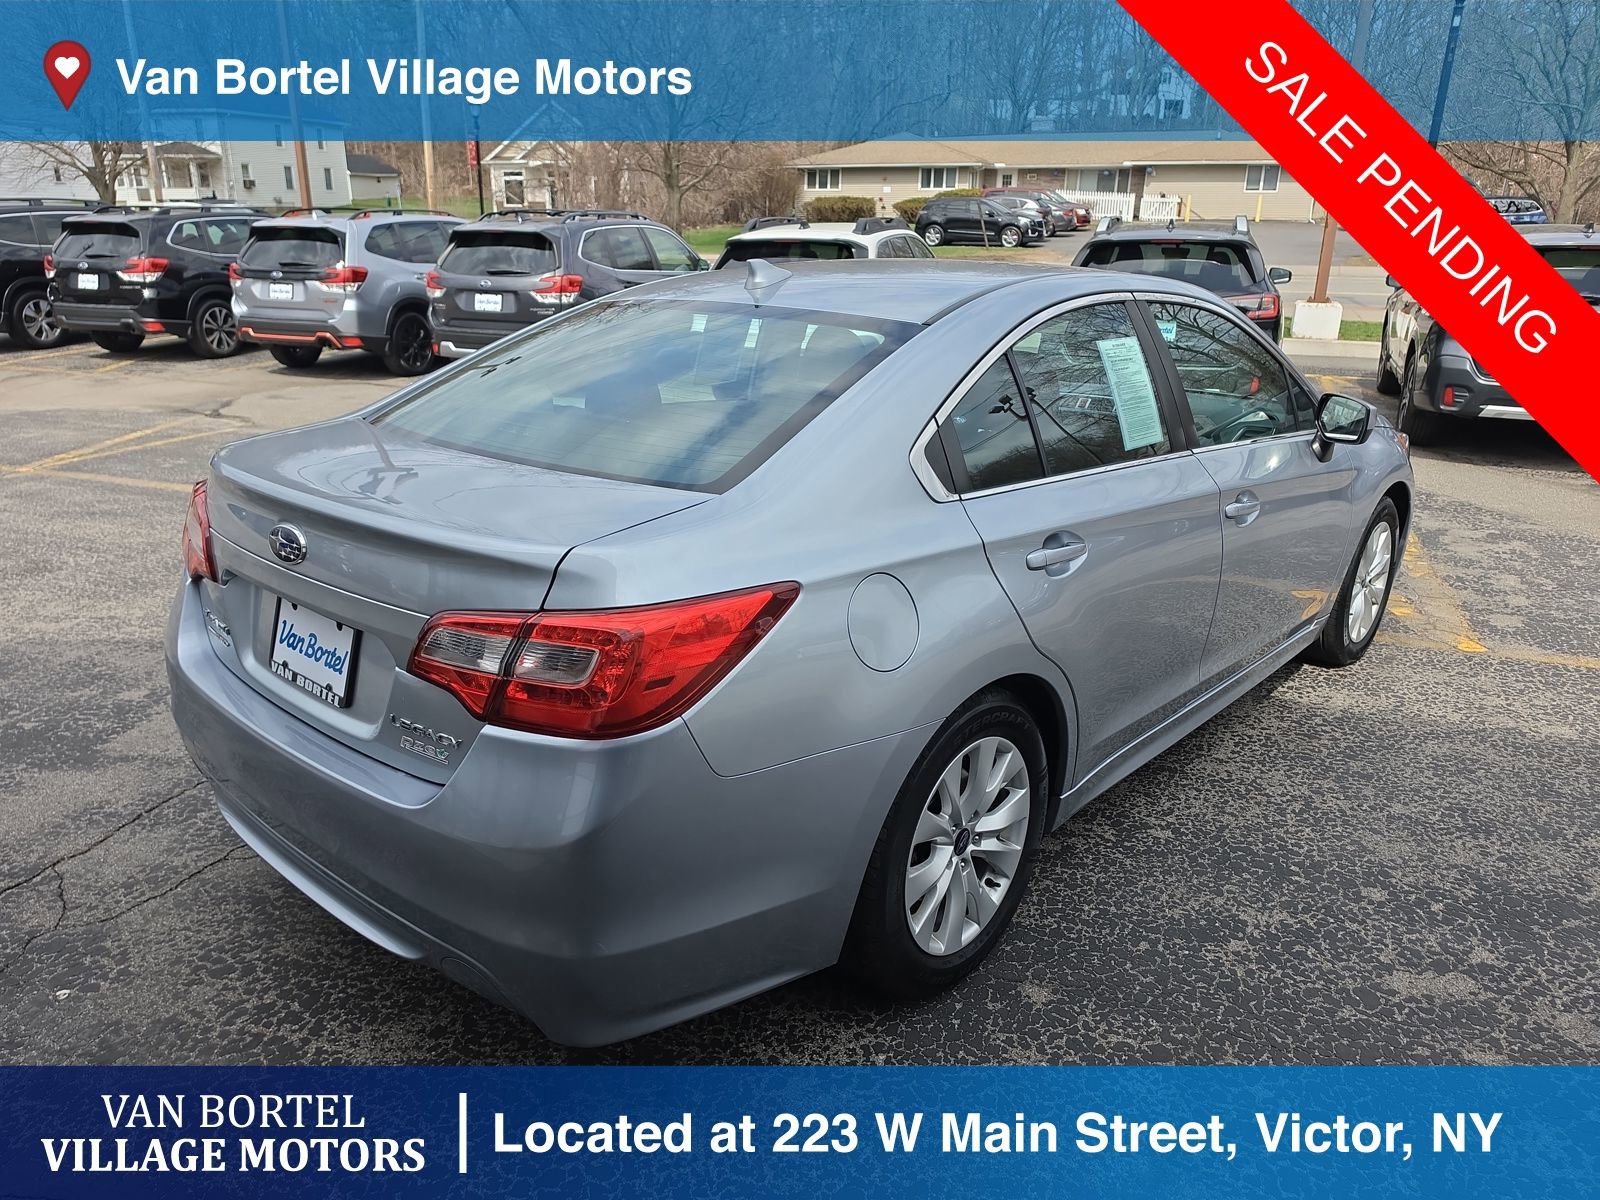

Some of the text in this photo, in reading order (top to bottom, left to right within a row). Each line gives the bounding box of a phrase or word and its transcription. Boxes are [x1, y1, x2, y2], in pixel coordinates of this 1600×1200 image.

[271, 660, 340, 708] VAN BORTEL
[389, 713, 462, 750] LEGACY
